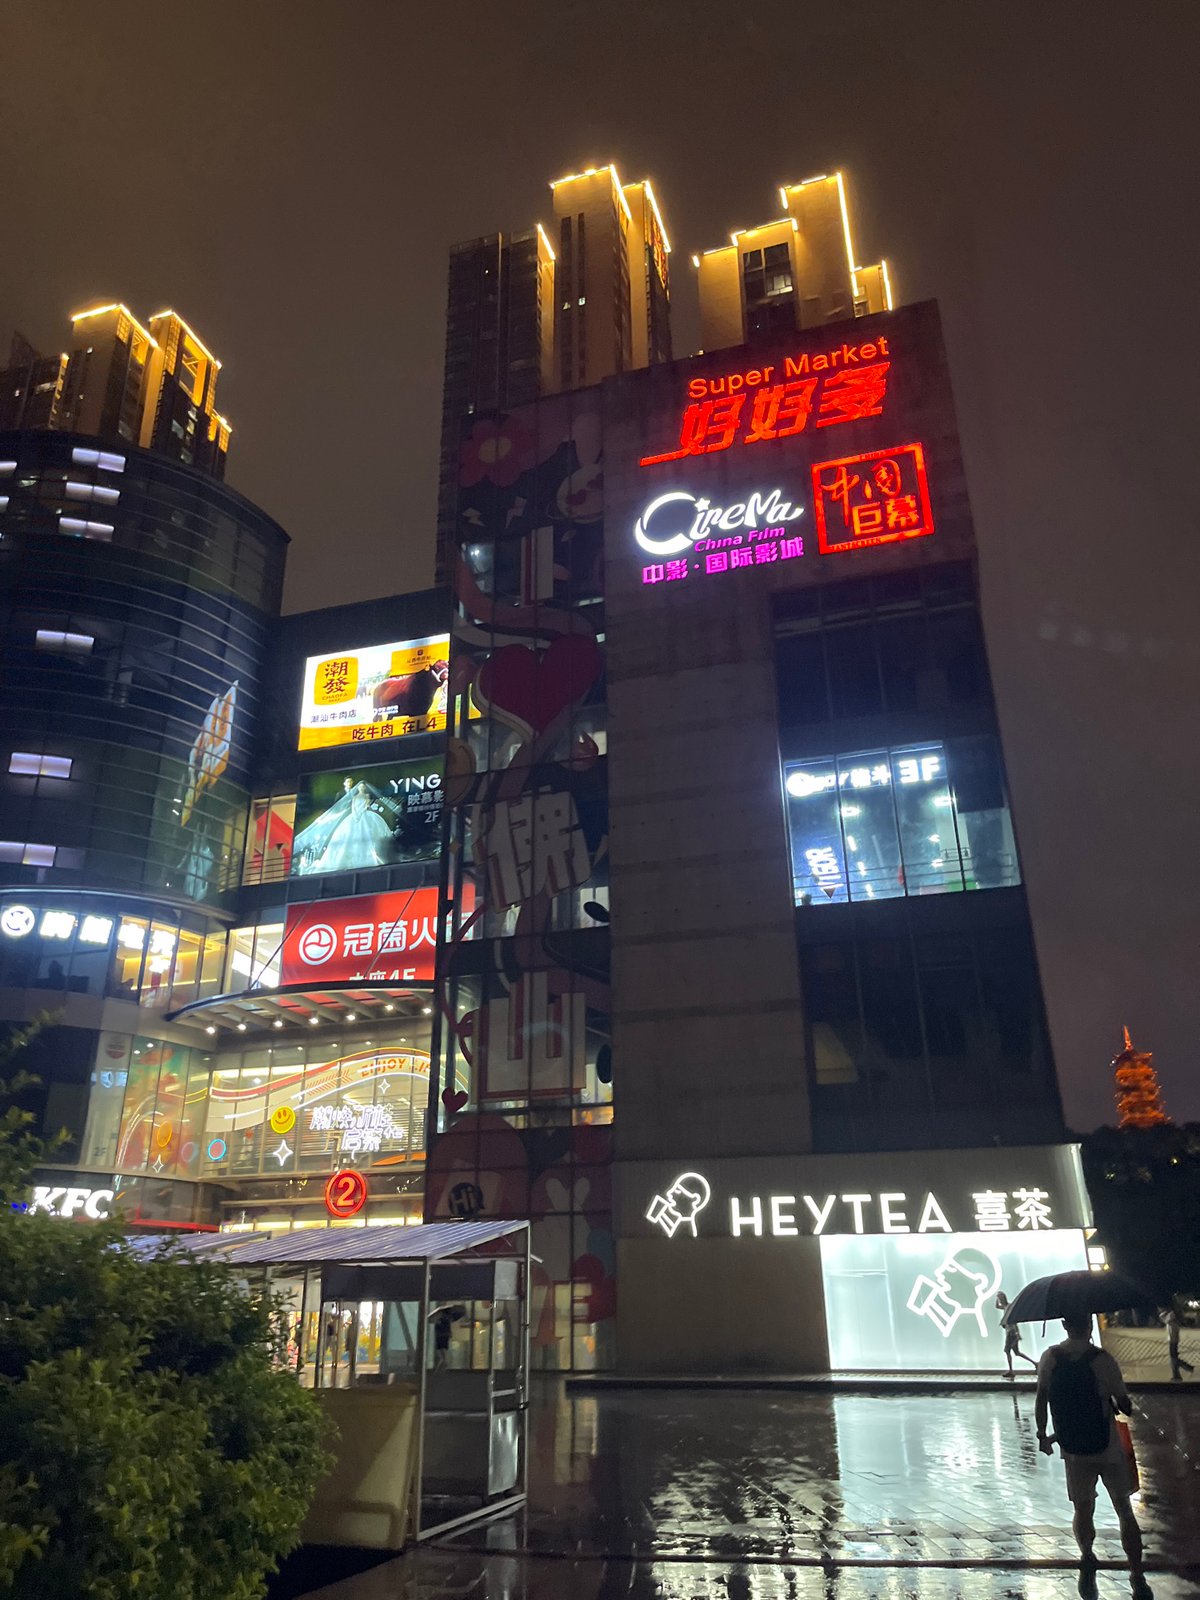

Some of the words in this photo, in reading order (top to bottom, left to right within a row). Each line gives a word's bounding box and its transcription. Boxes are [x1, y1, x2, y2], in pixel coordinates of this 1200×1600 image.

[688, 366, 774, 399] Super
[784, 336, 890, 377] Market
[639, 361, 891, 467] 好好多
[852, 494, 920, 537] 巨幕
[694, 535, 743, 552] China
[748, 527, 786, 543] Film
[352, 723, 394, 741] 吃牛肉
[390, 773, 442, 794] YING
[424, 812, 440, 824] 2F
[360, 1057, 407, 1078] ENJOY
[28, 1186, 114, 1219] KFC
[336, 1176, 356, 1207] 2
[730, 1191, 953, 1238] HEYTEA
[972, 1187, 1055, 1232] 喜茶
